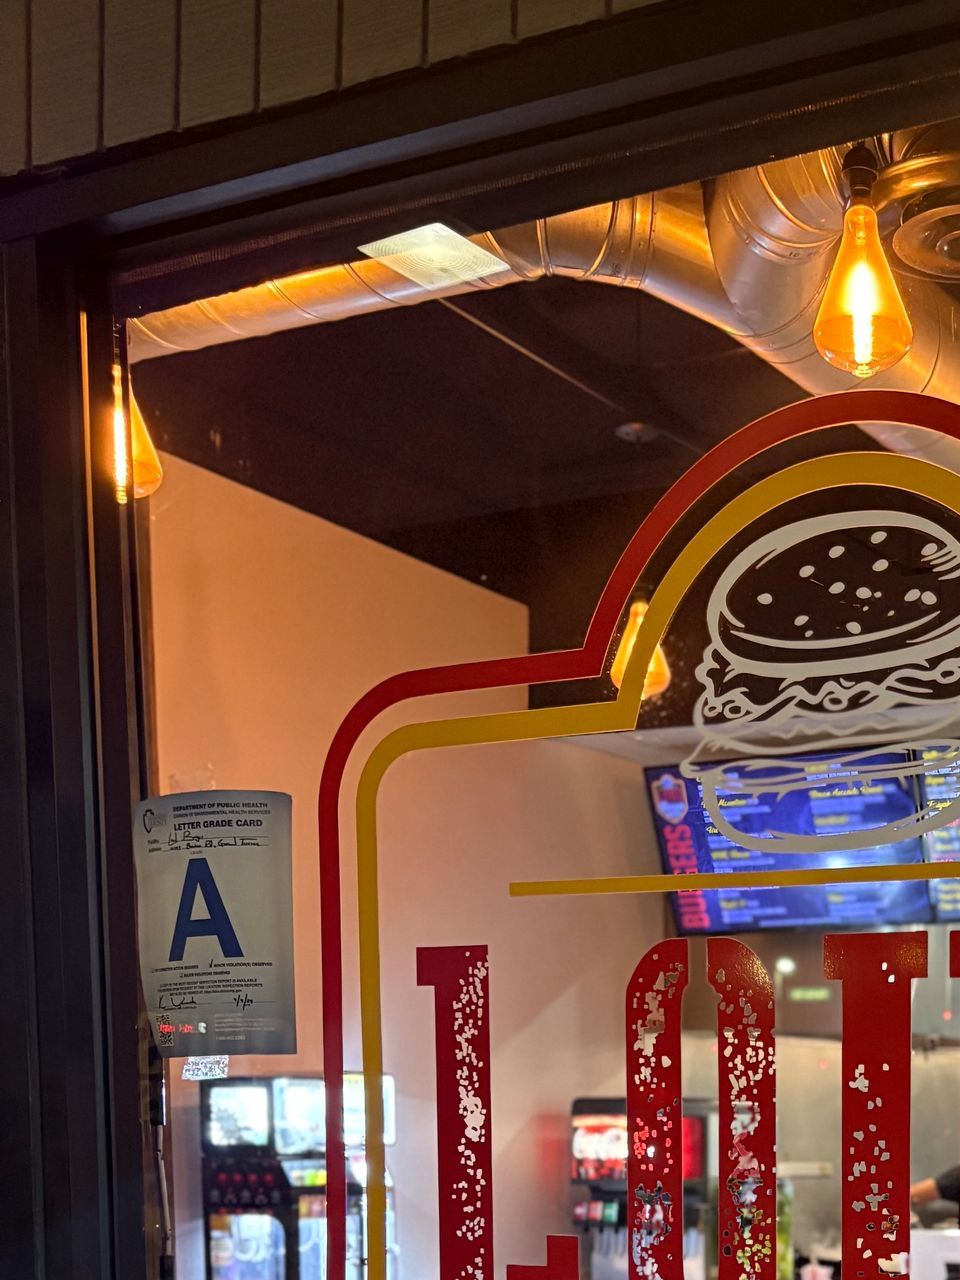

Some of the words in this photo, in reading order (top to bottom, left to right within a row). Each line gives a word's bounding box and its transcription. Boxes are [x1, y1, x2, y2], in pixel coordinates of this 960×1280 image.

[172, 803, 207, 812] DEPARTMENT
[216, 801, 241, 809] PUBLIC
[241, 801, 268, 809] HEALTH
[173, 821, 202, 831] LETTER
[202, 819, 233, 829] GRADE
[235, 818, 263, 828] CARD
[168, 857, 245, 962] A
